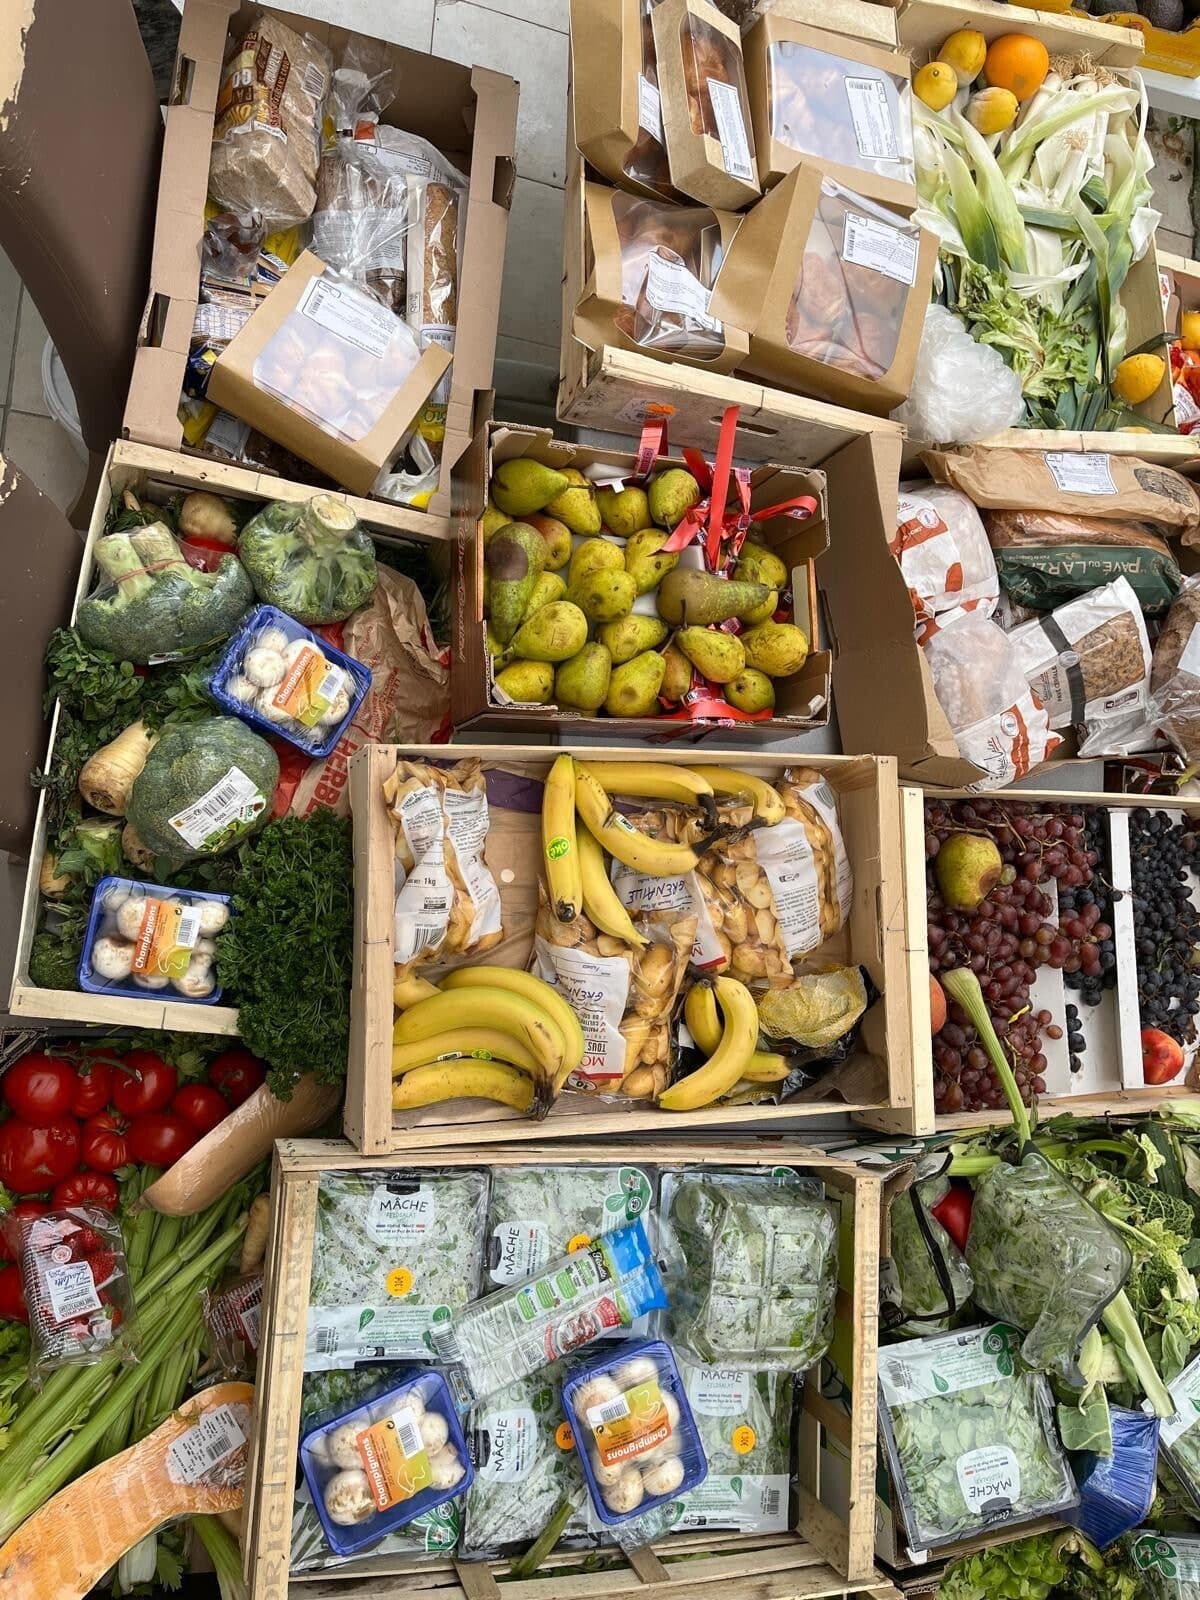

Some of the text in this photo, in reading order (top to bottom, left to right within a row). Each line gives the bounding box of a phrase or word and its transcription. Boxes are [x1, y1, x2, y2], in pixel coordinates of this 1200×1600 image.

[1103, 557, 1142, 573] PAVÉ
[277, 650, 312, 705] Champignons
[625, 879, 686, 904] GRENAILLE
[135, 905, 157, 969] Champignons
[587, 1041, 607, 1053] TOUS
[380, 1197, 428, 1212] MÂCHE
[503, 1227, 520, 1275] MÂCHE
[592, 1251, 606, 1279] Florette
[859, 1250, 877, 1504] PRINCE de BRETAGNE
[492, 1418, 508, 1472] MÂCHE
[606, 1426, 668, 1461] Champignons
[362, 1436, 389, 1506] Champignons
[969, 1477, 1012, 1498] MÂCHE
